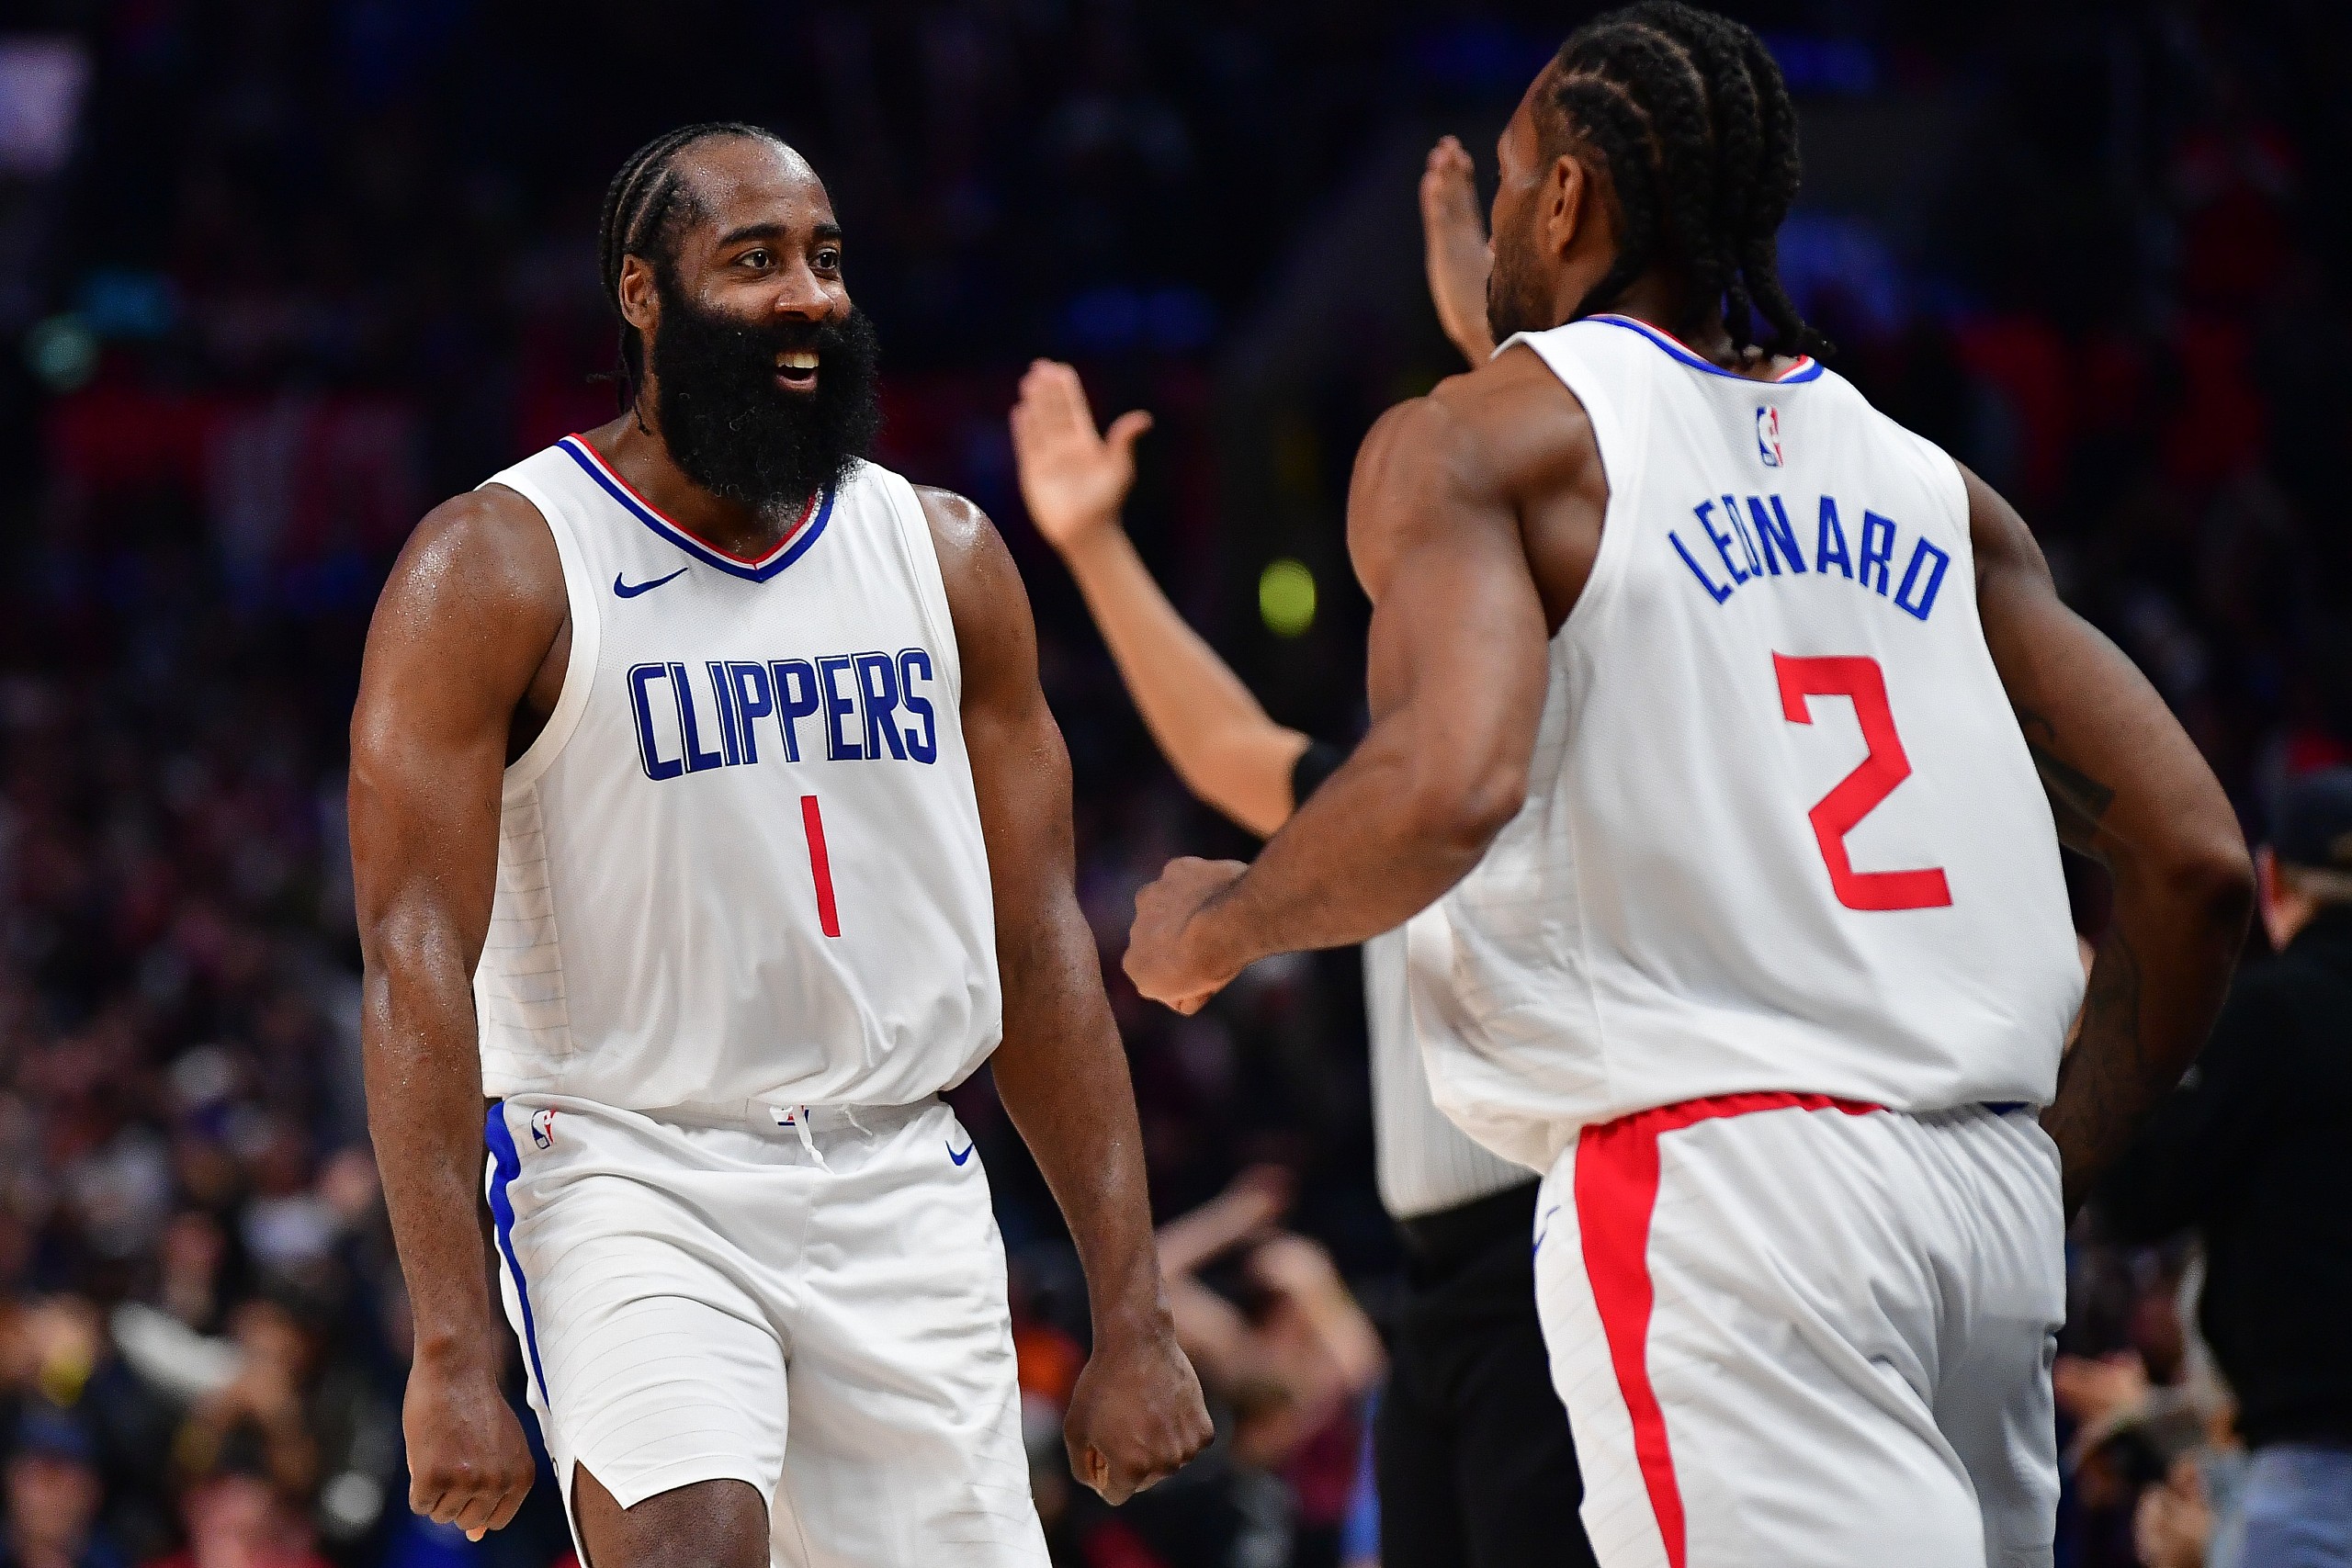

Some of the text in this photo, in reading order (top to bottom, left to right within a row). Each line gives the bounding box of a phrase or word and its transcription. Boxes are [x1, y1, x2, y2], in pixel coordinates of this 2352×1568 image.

[1668, 493, 1951, 622] LEONARD
[627, 648, 938, 781] CLIPPERS
[1771, 649, 1953, 911] 2
[800, 795, 841, 938] 1
